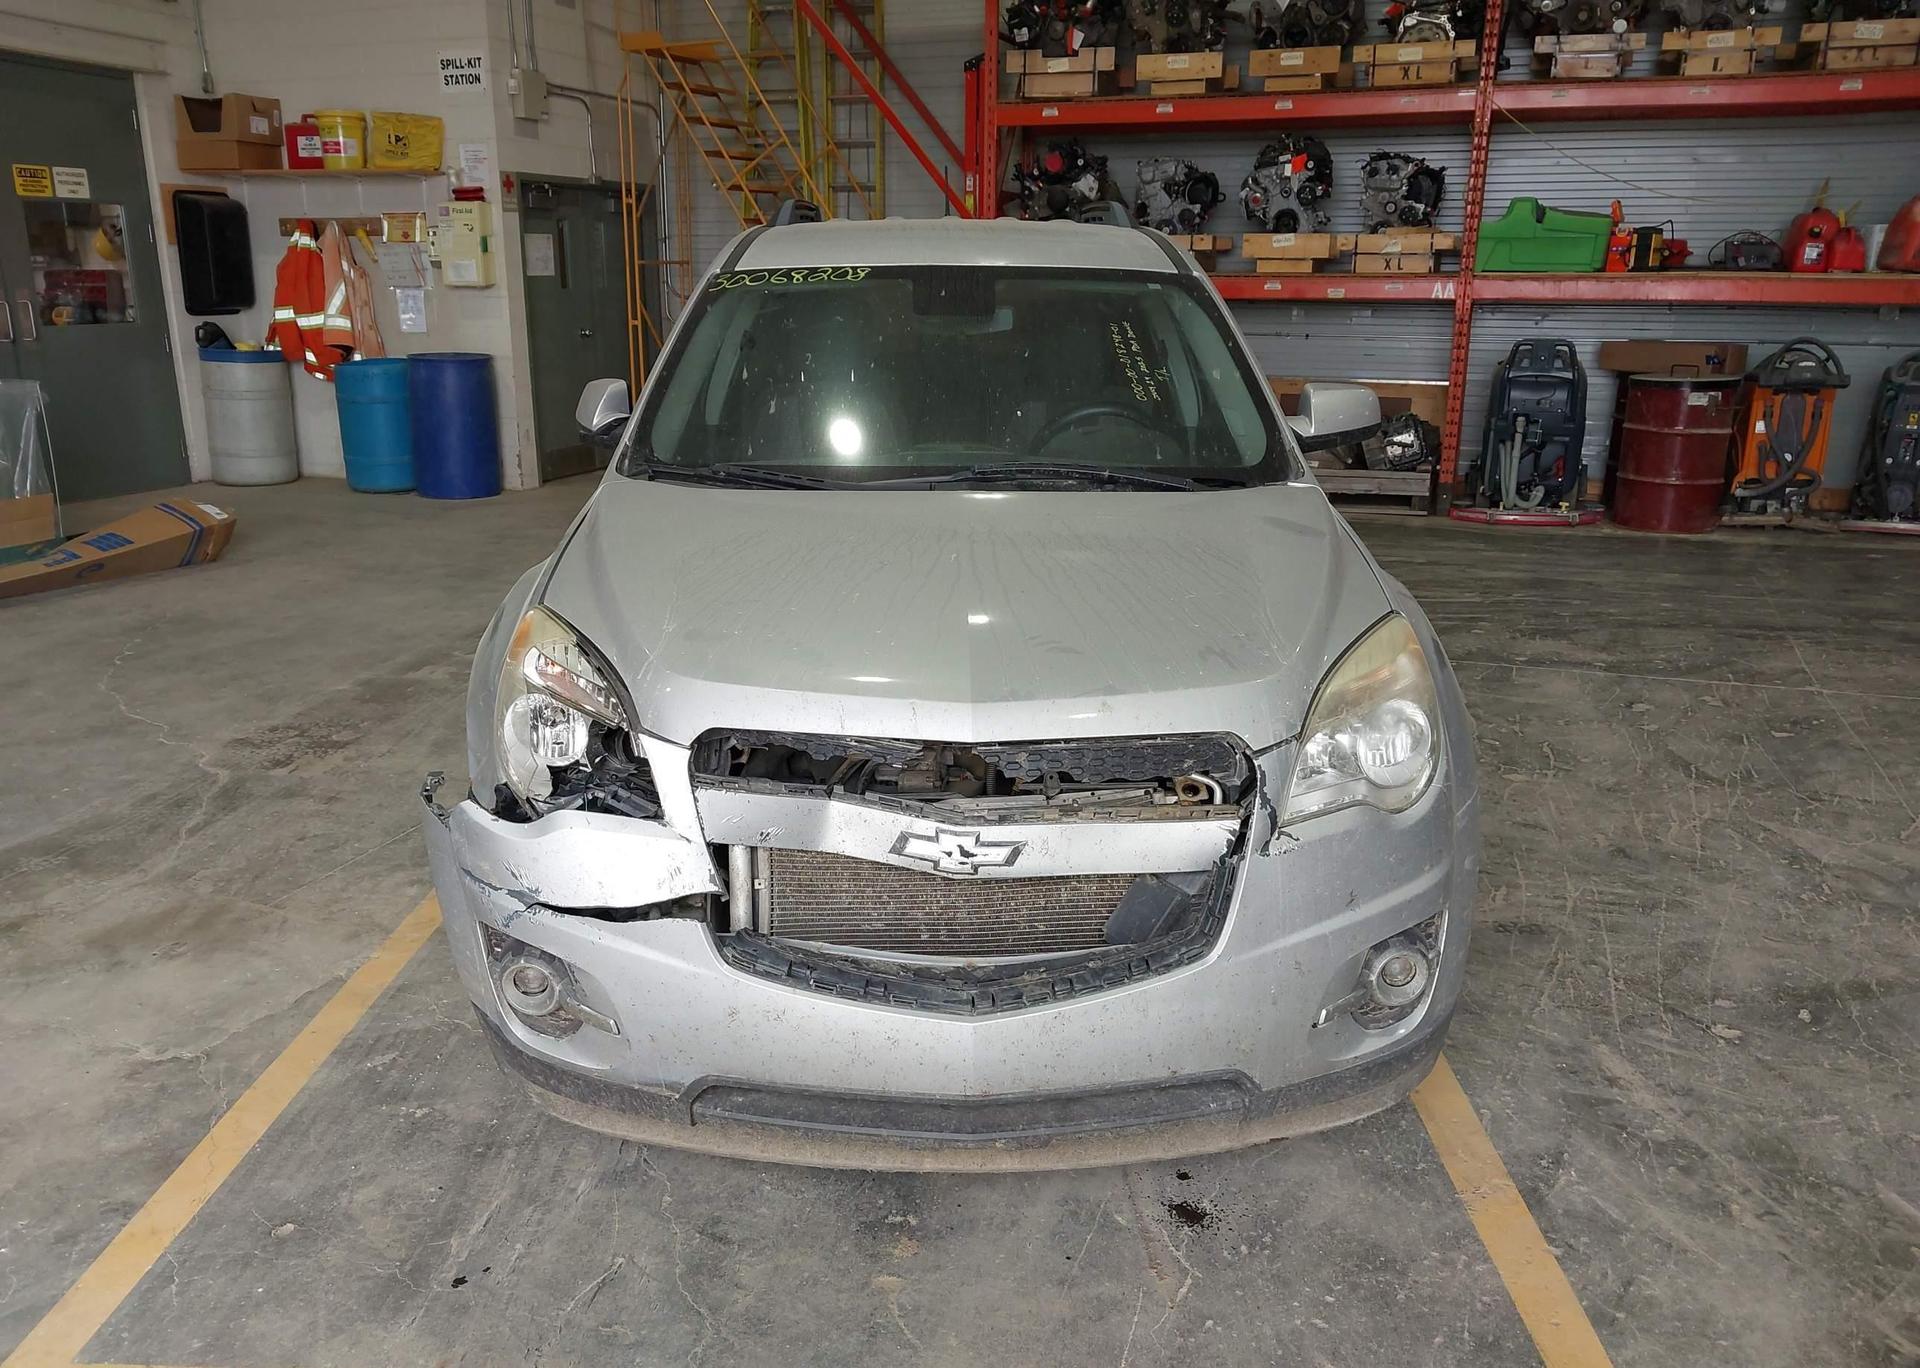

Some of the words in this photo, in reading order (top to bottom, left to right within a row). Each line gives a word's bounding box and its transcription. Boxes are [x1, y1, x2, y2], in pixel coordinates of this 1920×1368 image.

[440, 56, 482, 70] SPILL-KIT
[443, 72, 481, 86] STATION
[17, 168, 47, 178] CAUTION
[708, 267, 872, 292] 30068208
[1431, 280, 1456, 299] AA
